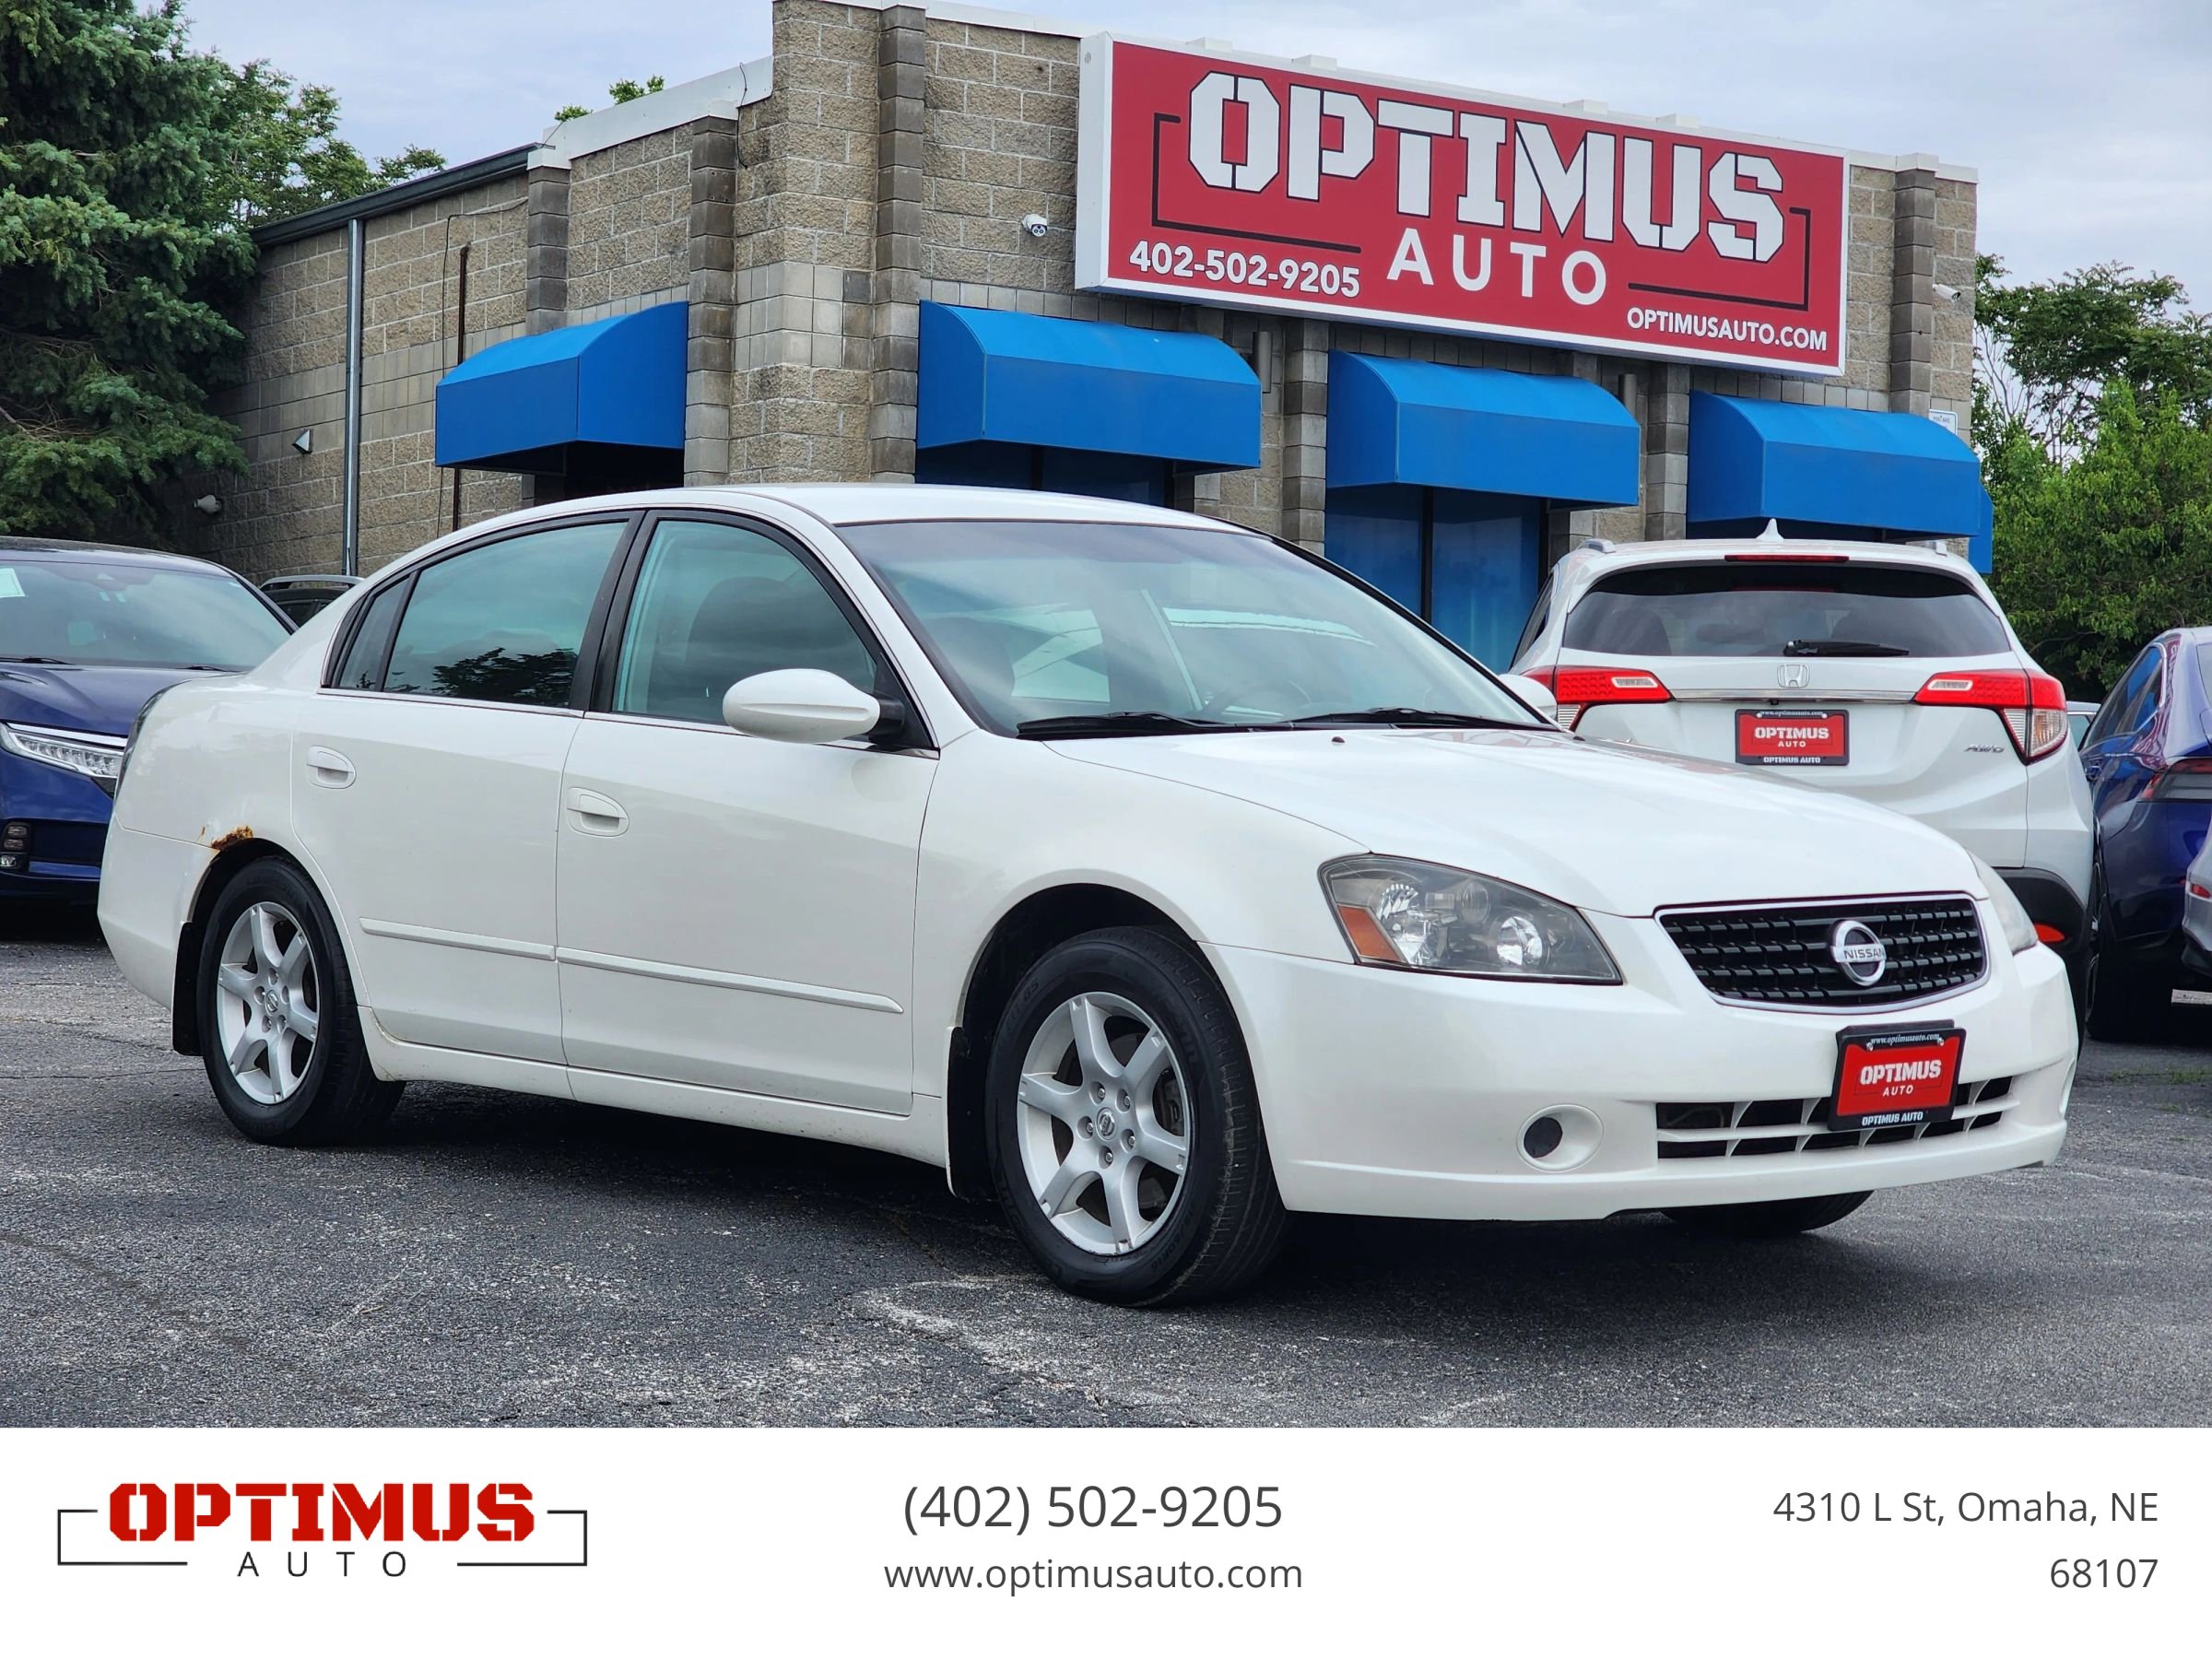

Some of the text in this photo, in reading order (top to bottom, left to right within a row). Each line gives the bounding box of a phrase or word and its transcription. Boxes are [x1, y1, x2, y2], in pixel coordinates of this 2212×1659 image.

[1189, 70, 1784, 264] OPTIMUS
[1129, 240, 1360, 299] 402-502-9205
[1386, 228, 1606, 305] AUTO
[1627, 307, 1828, 351] OPTIMUSAUTO.COM
[1755, 727, 1830, 739] OPTIMUS
[1843, 948, 1886, 959] NISSAN
[1870, 1033, 1940, 1046] www.optimusauto.com
[1860, 1059, 1942, 1085] OPTIMUS
[1882, 1084, 1914, 1098] AUTO
[1862, 1112, 1924, 1126] OPTIMUS AUTO
